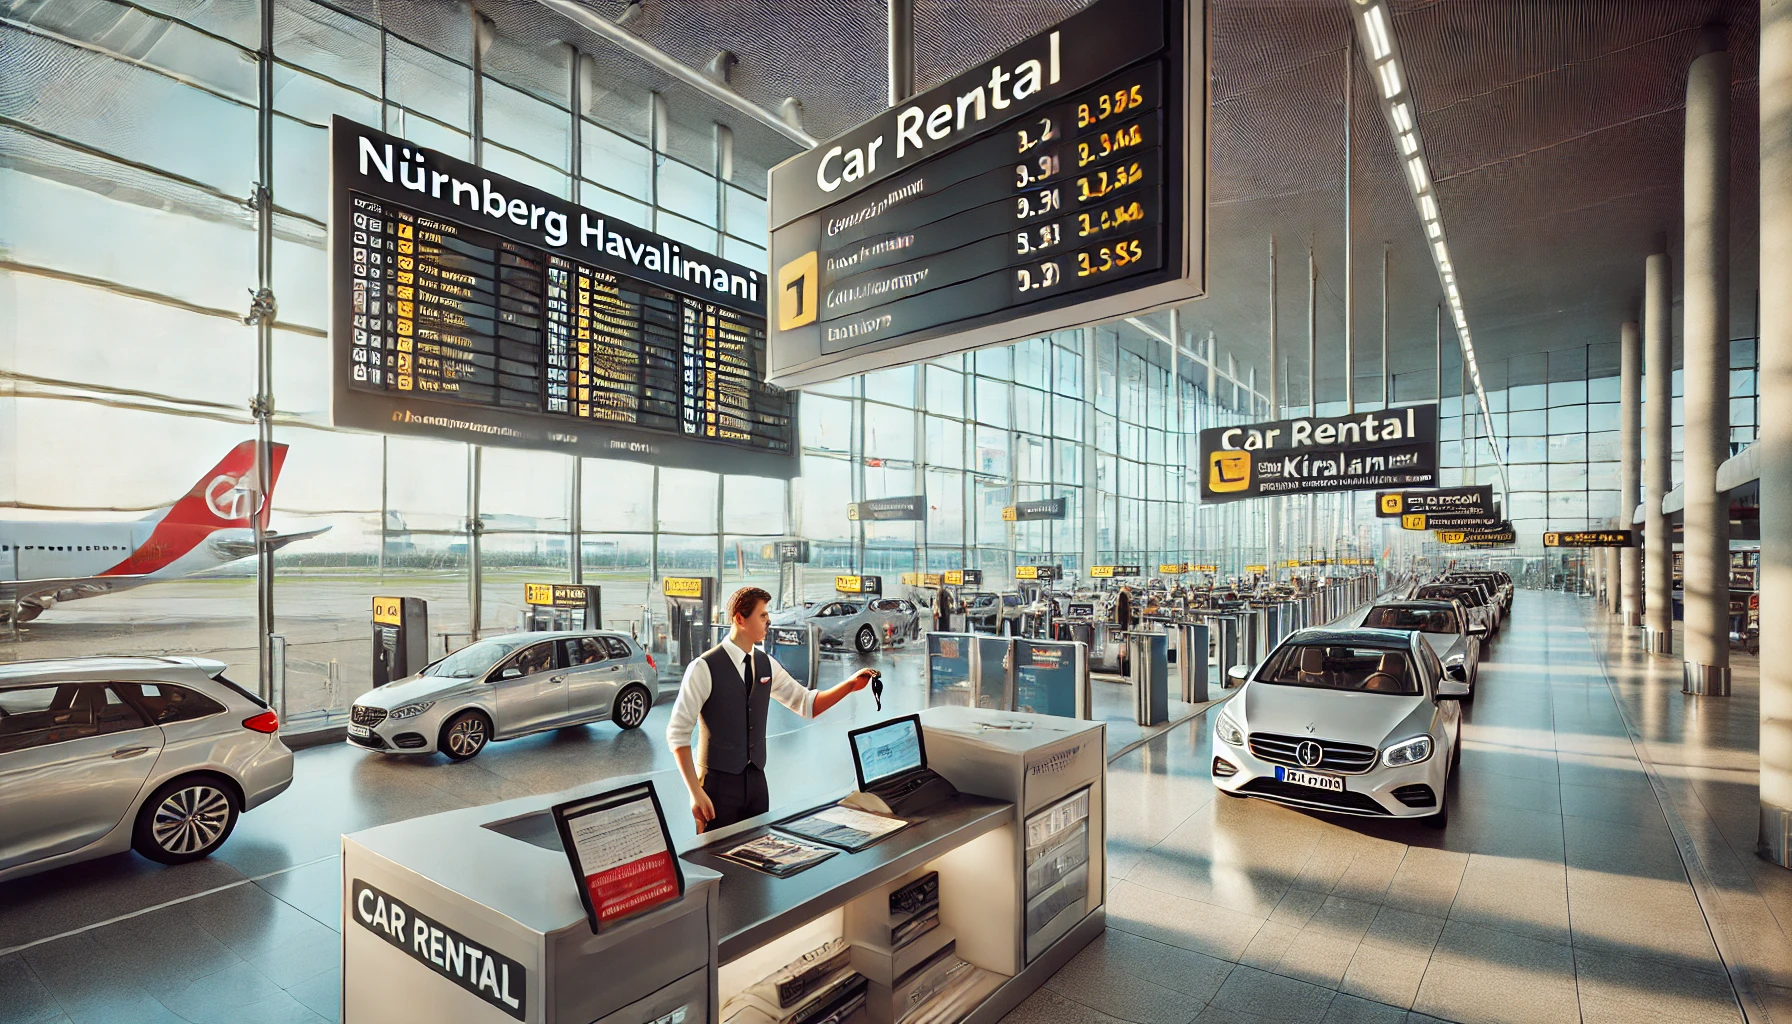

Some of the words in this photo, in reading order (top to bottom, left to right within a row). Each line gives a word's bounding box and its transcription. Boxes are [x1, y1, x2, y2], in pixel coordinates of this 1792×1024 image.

[816, 145, 883, 194] Car
[896, 30, 1061, 160] Rental
[358, 136, 569, 247] Nürnberg
[580, 213, 759, 302] Havalimani
[1221, 427, 1281, 451] Car
[1291, 408, 1415, 448] Rental
[357, 888, 406, 943] CAR
[413, 916, 519, 1010] RENTAL
